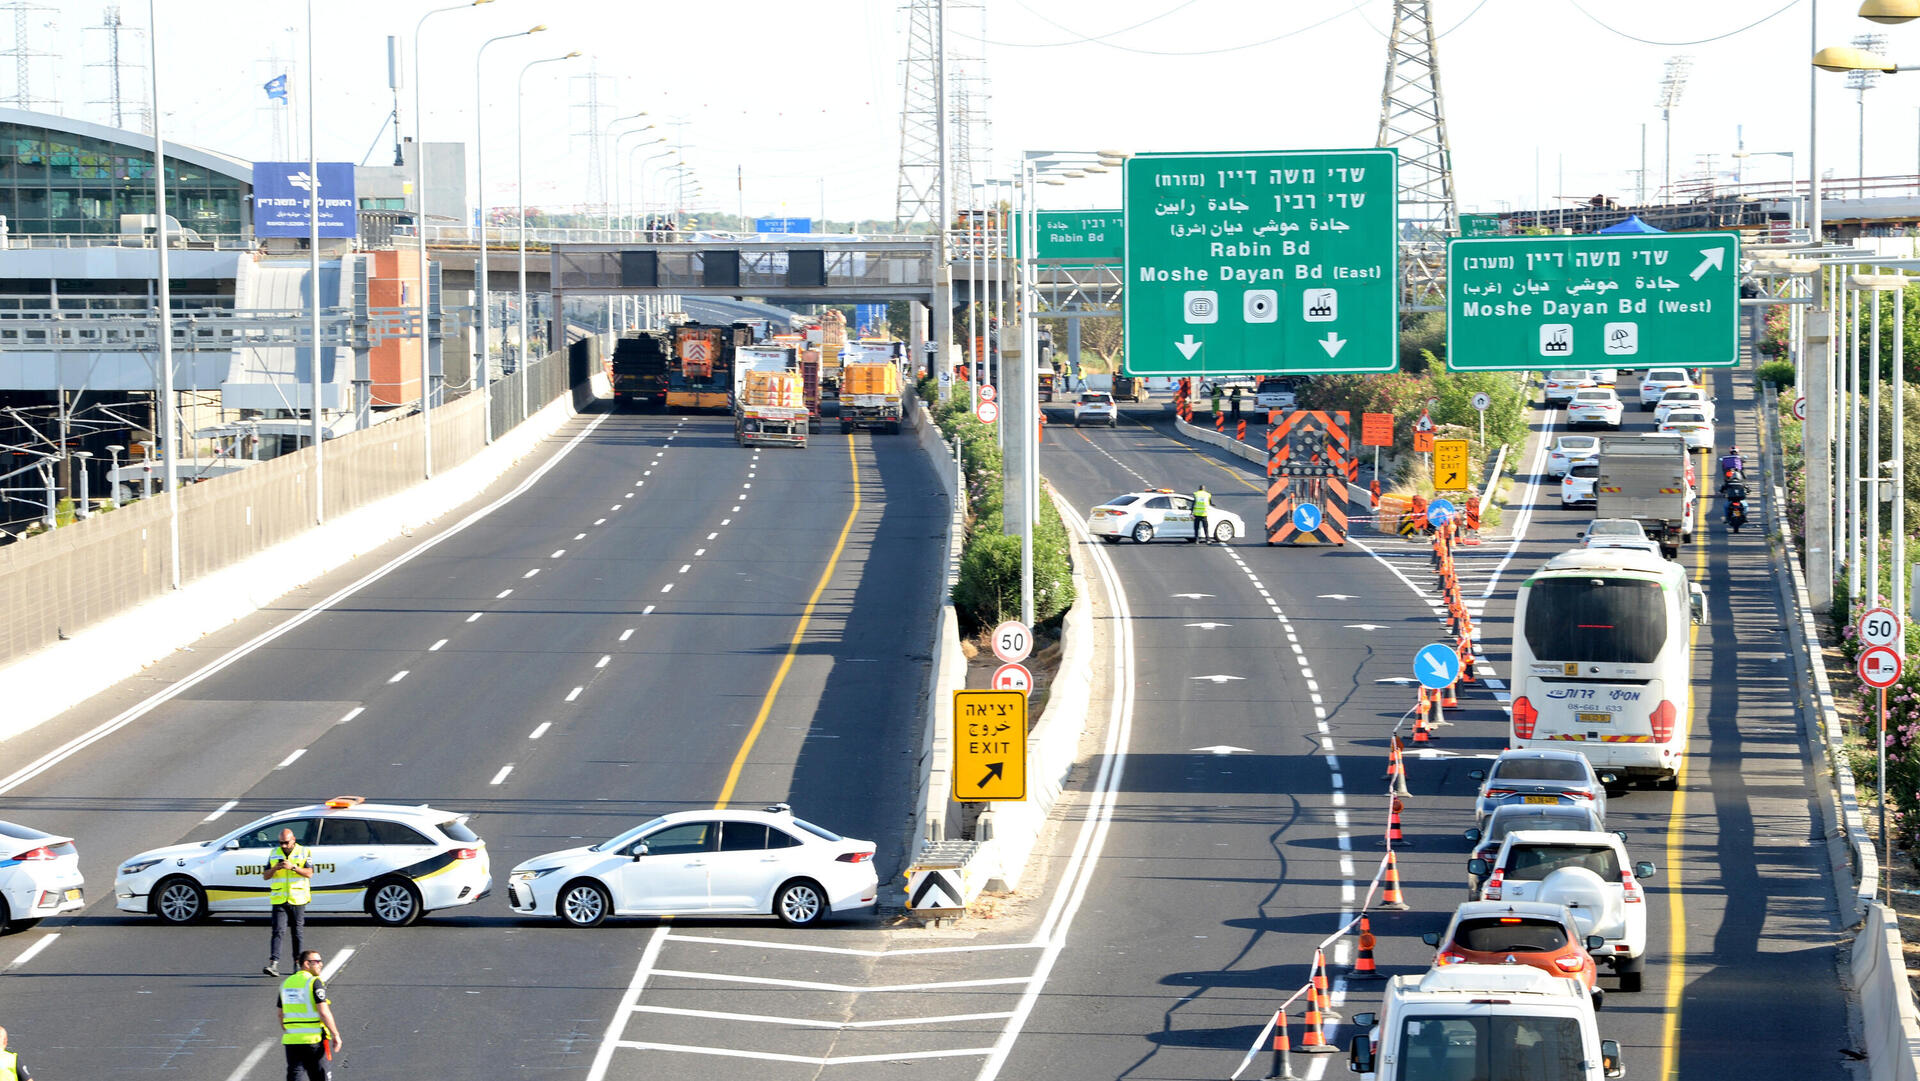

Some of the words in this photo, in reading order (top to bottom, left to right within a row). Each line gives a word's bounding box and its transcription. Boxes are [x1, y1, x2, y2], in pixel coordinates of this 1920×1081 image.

[1155, 174, 1205, 188] (מזרח)
[1217, 170, 1257, 189] דיין
[1269, 169, 1315, 185] משה
[1155, 199, 1196, 217] رابين
[1208, 198, 1250, 214] جادة
[1273, 195, 1316, 213] רבין
[1080, 218, 1105, 230] רבין
[1170, 224, 1206, 238] (شرق)
[1210, 221, 1243, 238] ديان
[1253, 220, 1300, 238] موشي
[1309, 218, 1350, 234] جادة
[1050, 233, 1083, 243] Rabin
[1088, 232, 1104, 242] Bd
[1210, 242, 1271, 257] Rabin
[1282, 241, 1310, 256] Bd
[1463, 256, 1515, 271] (מערב)
[1526, 253, 1564, 271] דיין
[1575, 252, 1621, 268] משה
[1140, 267, 1209, 282] Moshe
[1220, 266, 1284, 284] Dayan
[1295, 264, 1323, 280] Bd
[1333, 266, 1381, 280] (East)
[1463, 283, 1502, 297] (غرب)
[1512, 279, 1550, 297] ديان
[1566, 279, 1619, 297] موشي
[1635, 277, 1680, 292] جادة
[1463, 301, 1532, 317] Moshe
[1543, 301, 1608, 319] Dayan
[1618, 299, 1647, 314] Bd
[1658, 300, 1712, 314] (West)
[1867, 619, 1892, 638] 50
[1002, 633, 1024, 651] 50
[966, 703, 1014, 716] יציאה
[968, 721, 1012, 737] خروج
[969, 742, 1010, 754] EXIT
